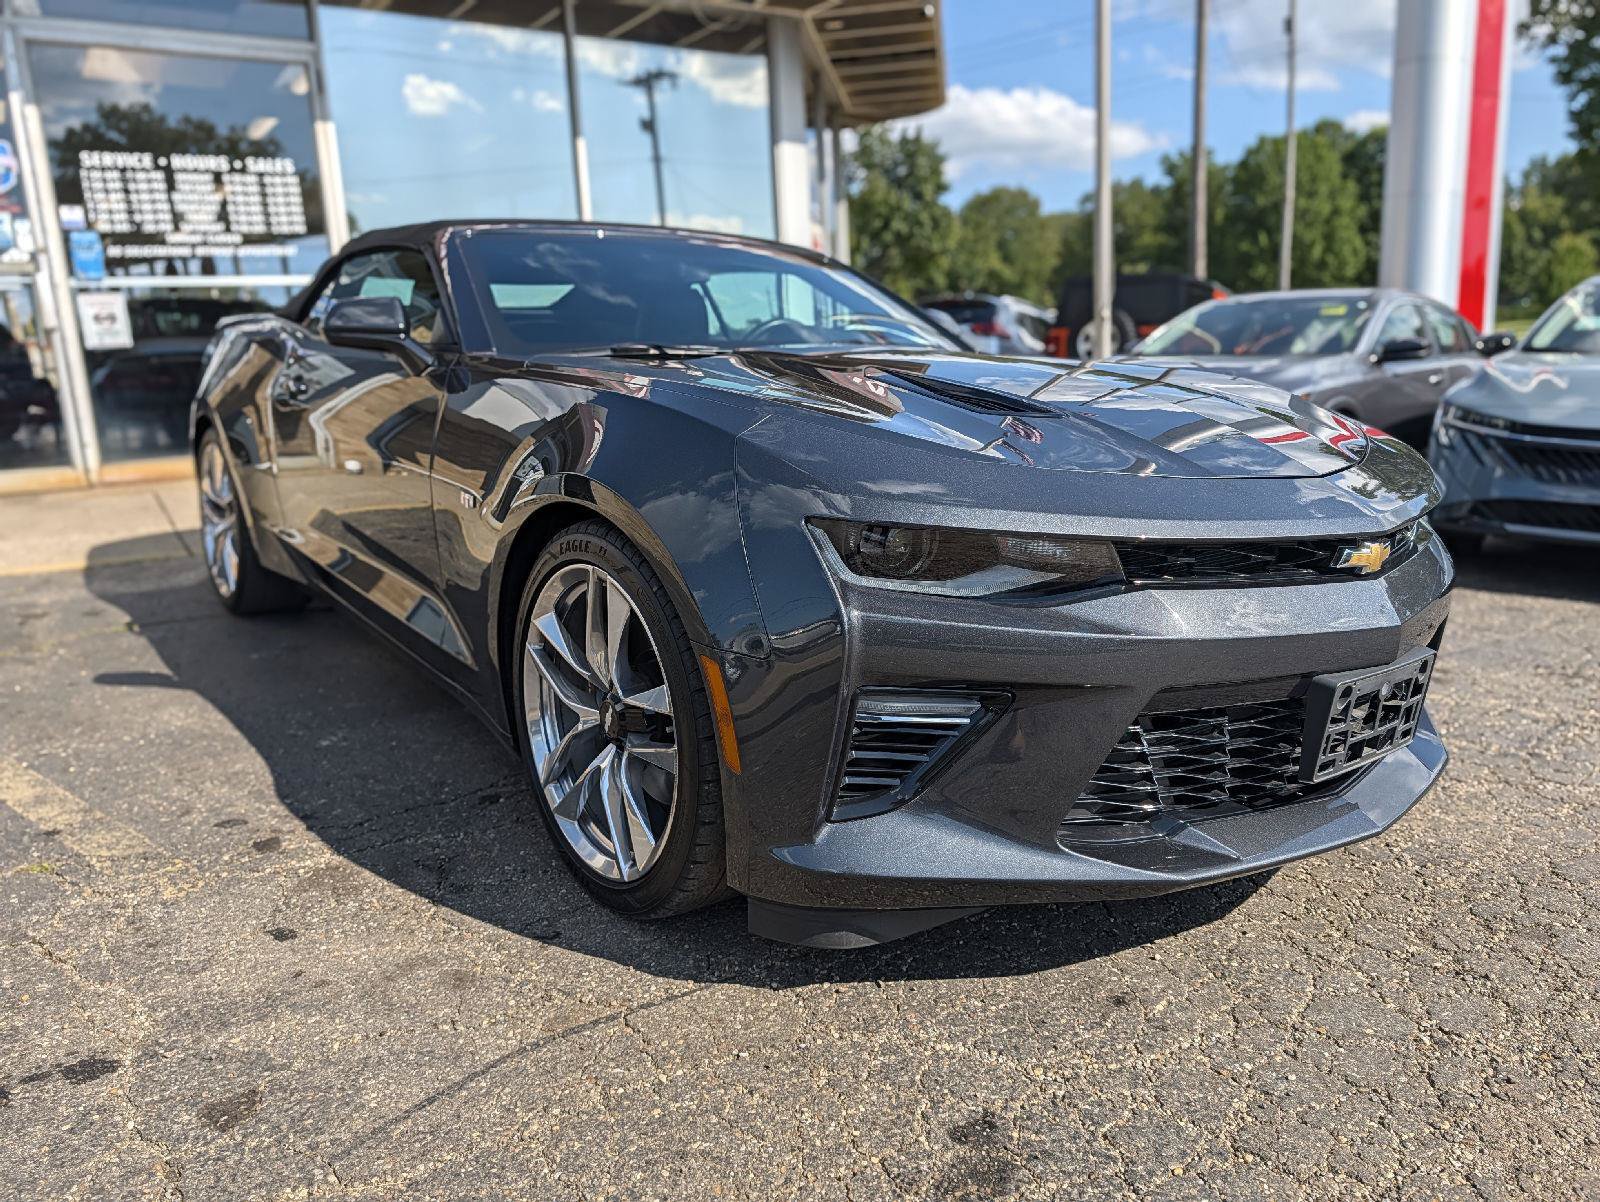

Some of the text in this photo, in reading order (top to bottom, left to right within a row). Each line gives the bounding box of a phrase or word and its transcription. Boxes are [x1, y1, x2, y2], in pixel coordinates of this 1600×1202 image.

[79, 150, 296, 174] SERVICE HOURS SALES
[559, 540, 591, 555] EAGLE
